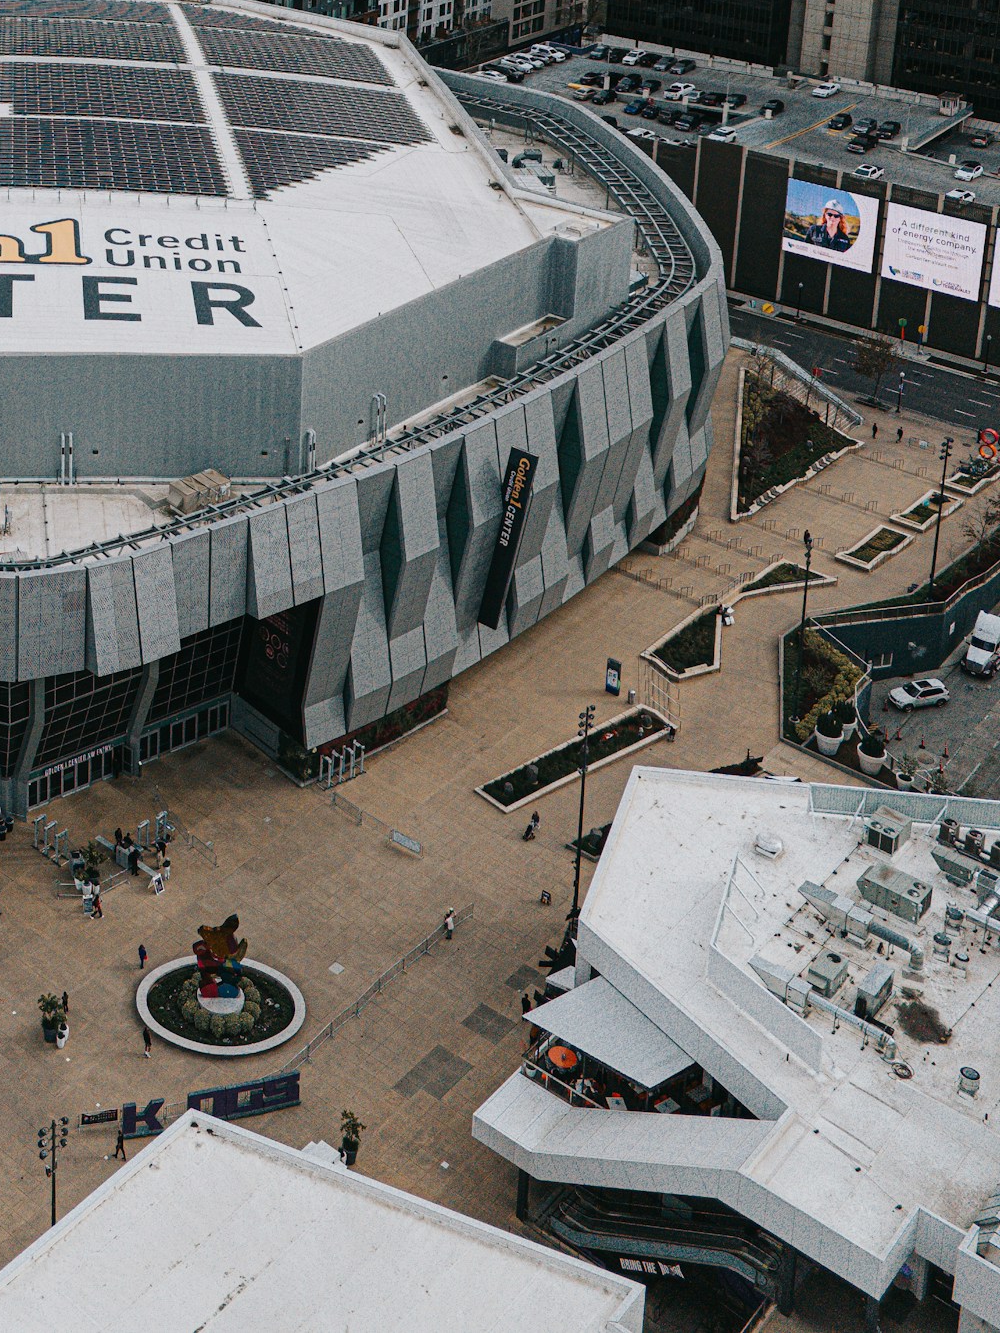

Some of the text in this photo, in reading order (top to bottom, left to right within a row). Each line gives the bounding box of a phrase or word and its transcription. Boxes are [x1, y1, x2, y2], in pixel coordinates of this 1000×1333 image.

[104, 228, 247, 252] Credit
[901, 219, 970, 242] A different kind
[903, 229, 934, 243] energy
[105, 248, 242, 273] Union
[499, 505, 516, 547] CENTER
[44, 763, 64, 777] GOLDEN
[68, 754, 86, 767] CENTER
[96, 745, 112, 756] ENTRY
[619, 1257, 643, 1272] BRING
[642, 1260, 657, 1274] THE
